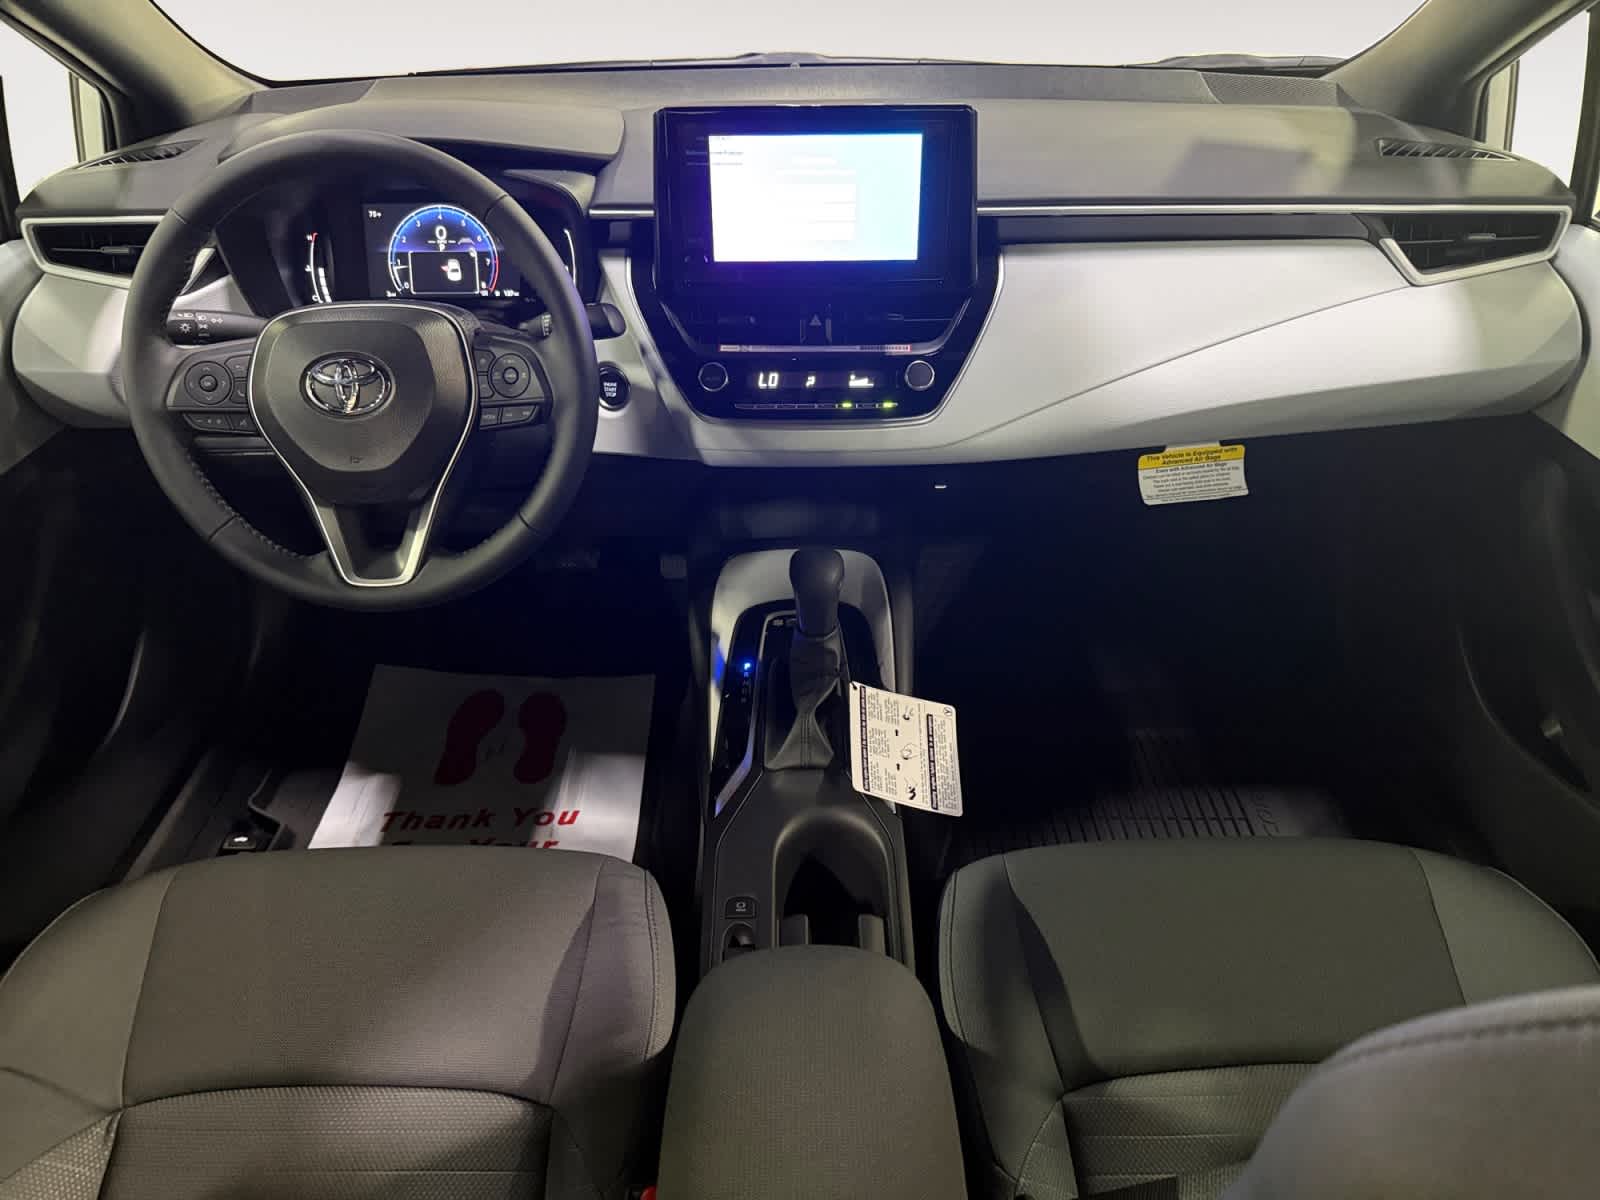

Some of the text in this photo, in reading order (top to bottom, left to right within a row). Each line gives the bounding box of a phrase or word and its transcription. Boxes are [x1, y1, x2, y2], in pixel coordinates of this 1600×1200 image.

[435, 225, 447, 240] 0
[381, 806, 582, 832] Thank You
